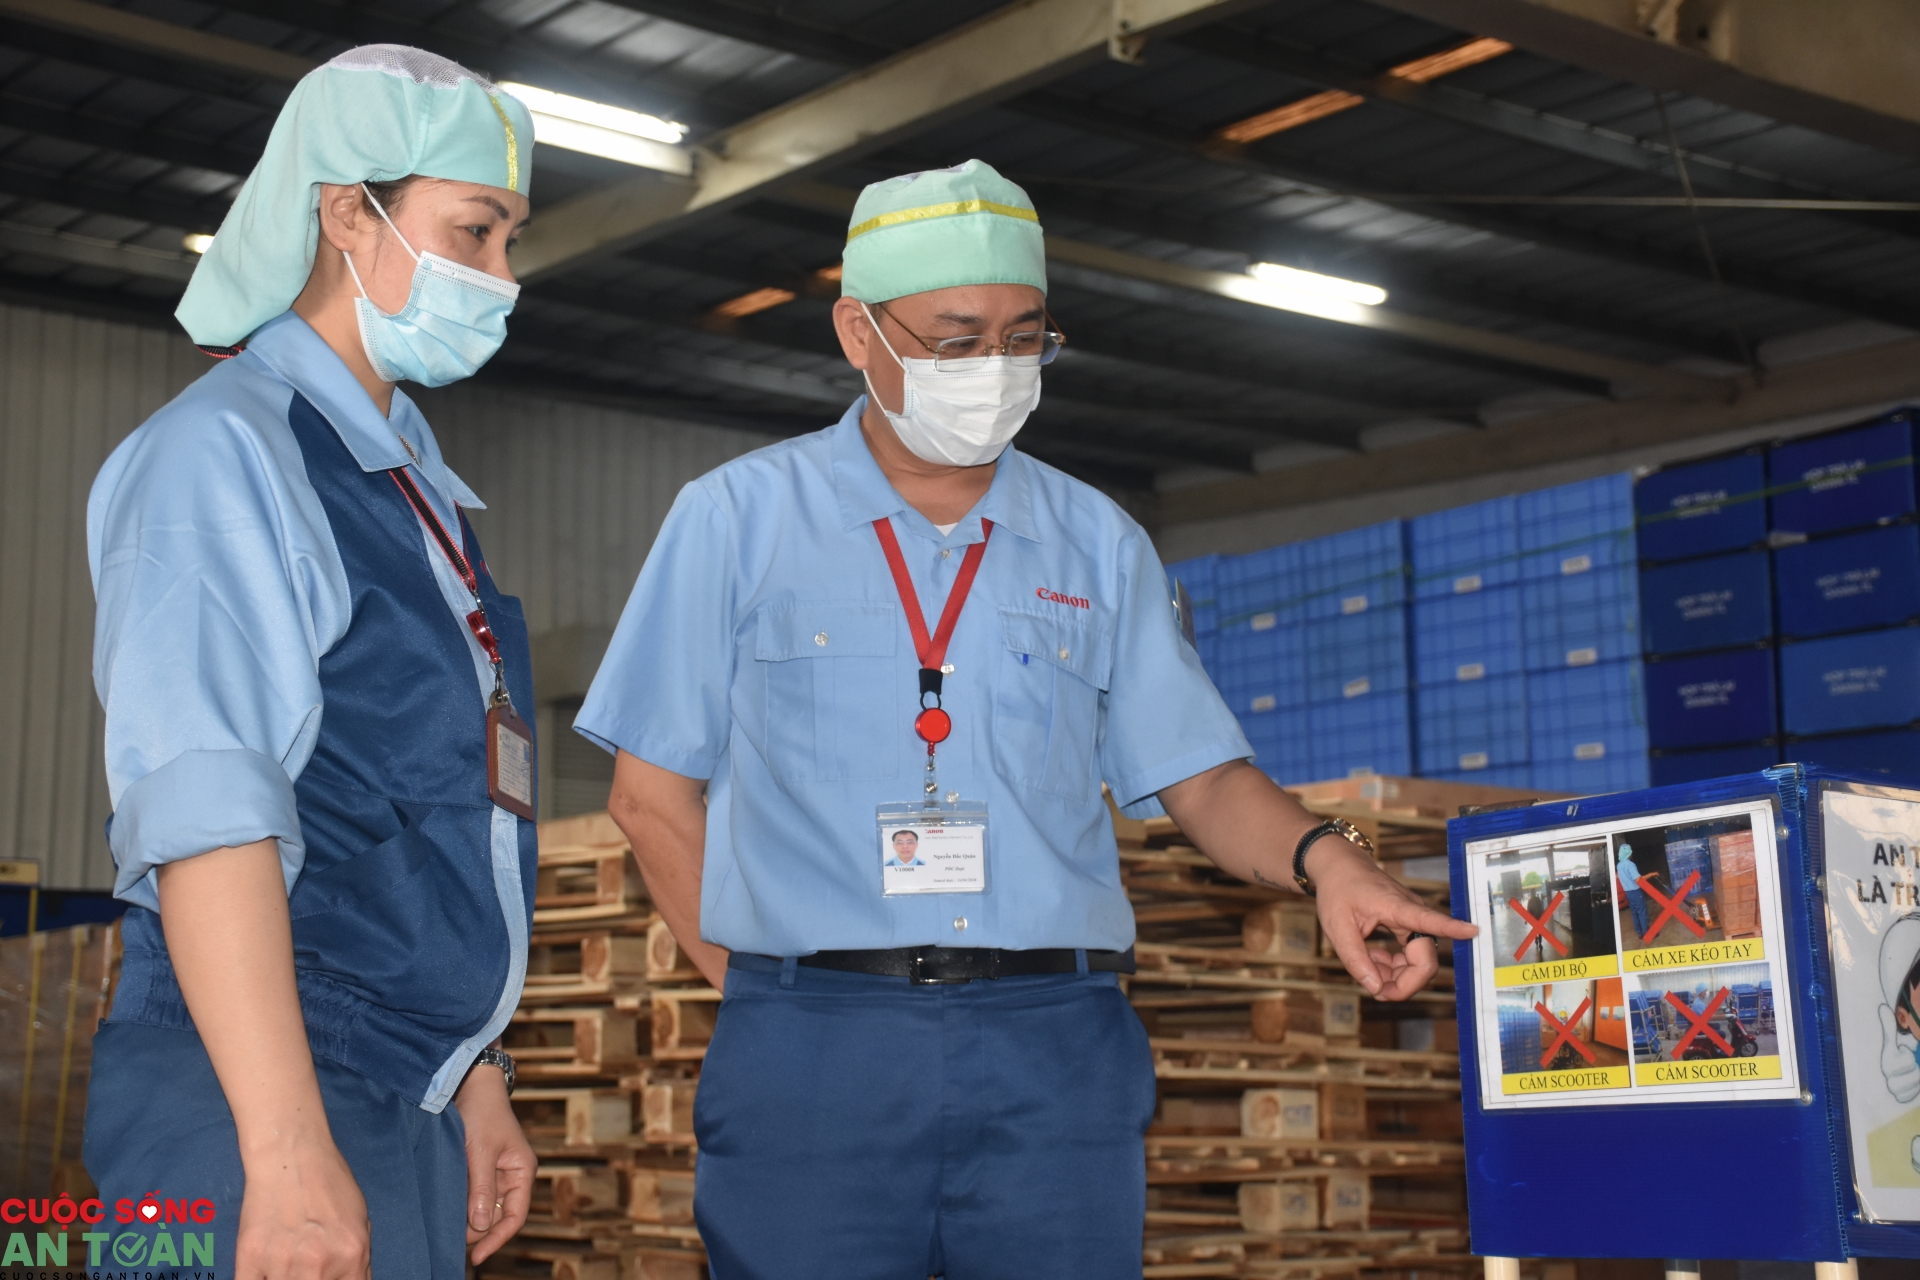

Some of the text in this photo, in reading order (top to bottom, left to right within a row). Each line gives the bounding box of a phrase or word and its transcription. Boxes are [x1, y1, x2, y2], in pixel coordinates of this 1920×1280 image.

[1036, 587, 1089, 610] Canon
[1873, 842, 1905, 867] AN
[1857, 875, 1887, 904] LÀ
[1668, 950, 1687, 964] XE
[1690, 944, 1719, 962] KÉO
[1723, 944, 1752, 959] TAY
[1553, 964, 1566, 978] ĐI
[1569, 960, 1587, 978] BỘ
[1550, 1072, 1610, 1088] SCOOTER
[1691, 1062, 1759, 1079] SCOOTER
